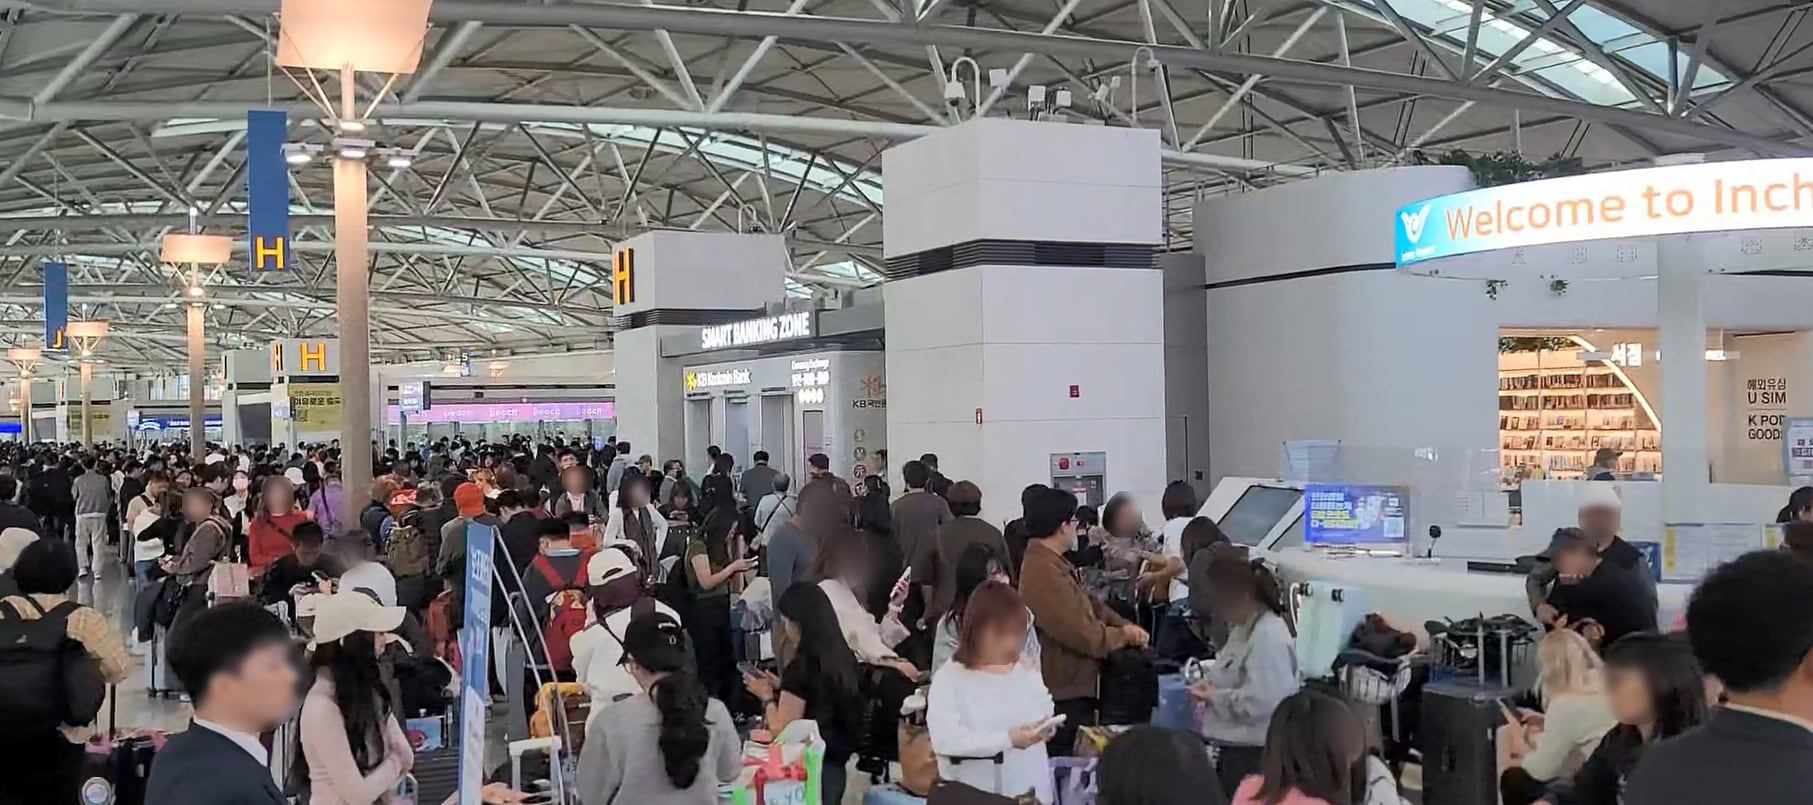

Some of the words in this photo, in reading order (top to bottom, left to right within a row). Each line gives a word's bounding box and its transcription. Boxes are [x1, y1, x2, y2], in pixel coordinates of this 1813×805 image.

[1445, 195, 1626, 241] Welcome
[1642, 185, 1695, 219] to
[256, 236, 284, 269] H
[614, 246, 634, 304] H
[702, 323, 732, 348] SMART
[733, 317, 778, 345] BANKING
[779, 311, 810, 339] ZONE
[300, 341, 326, 371] H
[697, 372, 707, 387] KB
[733, 368, 751, 384] Bank
[1748, 392, 1757, 404] U
[1761, 391, 1786, 404] SIM
[1748, 415, 1757, 426] K
